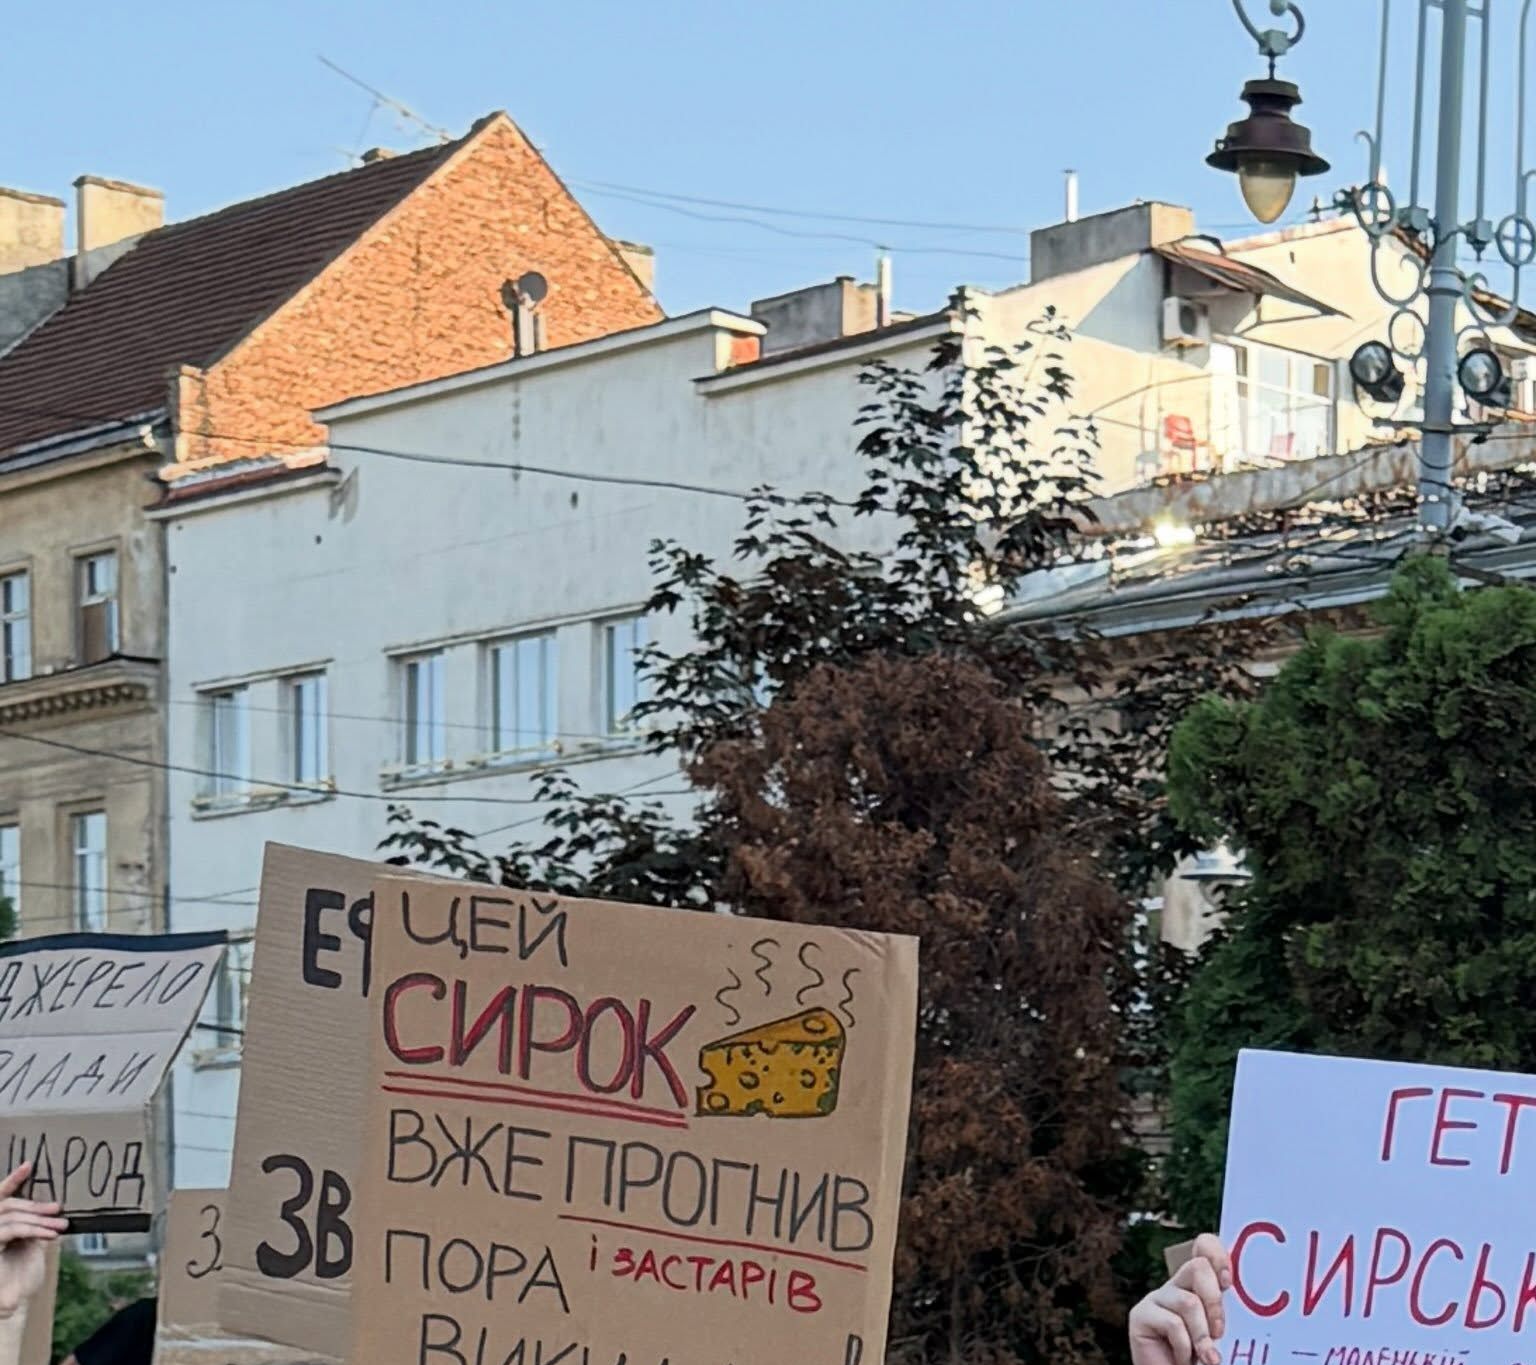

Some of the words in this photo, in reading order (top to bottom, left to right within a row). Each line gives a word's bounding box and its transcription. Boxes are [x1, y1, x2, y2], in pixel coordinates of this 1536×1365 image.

[402, 889, 569, 967] ЦЕЙ
[382, 972, 698, 1109] СИРОК
[386, 1109, 549, 1201] ВЖЕ
[564, 1136, 877, 1254] ПРОГНИВ
[384, 1229, 571, 1315] ПОРА
[613, 1246, 824, 1314] ЗАСТАРІВ
